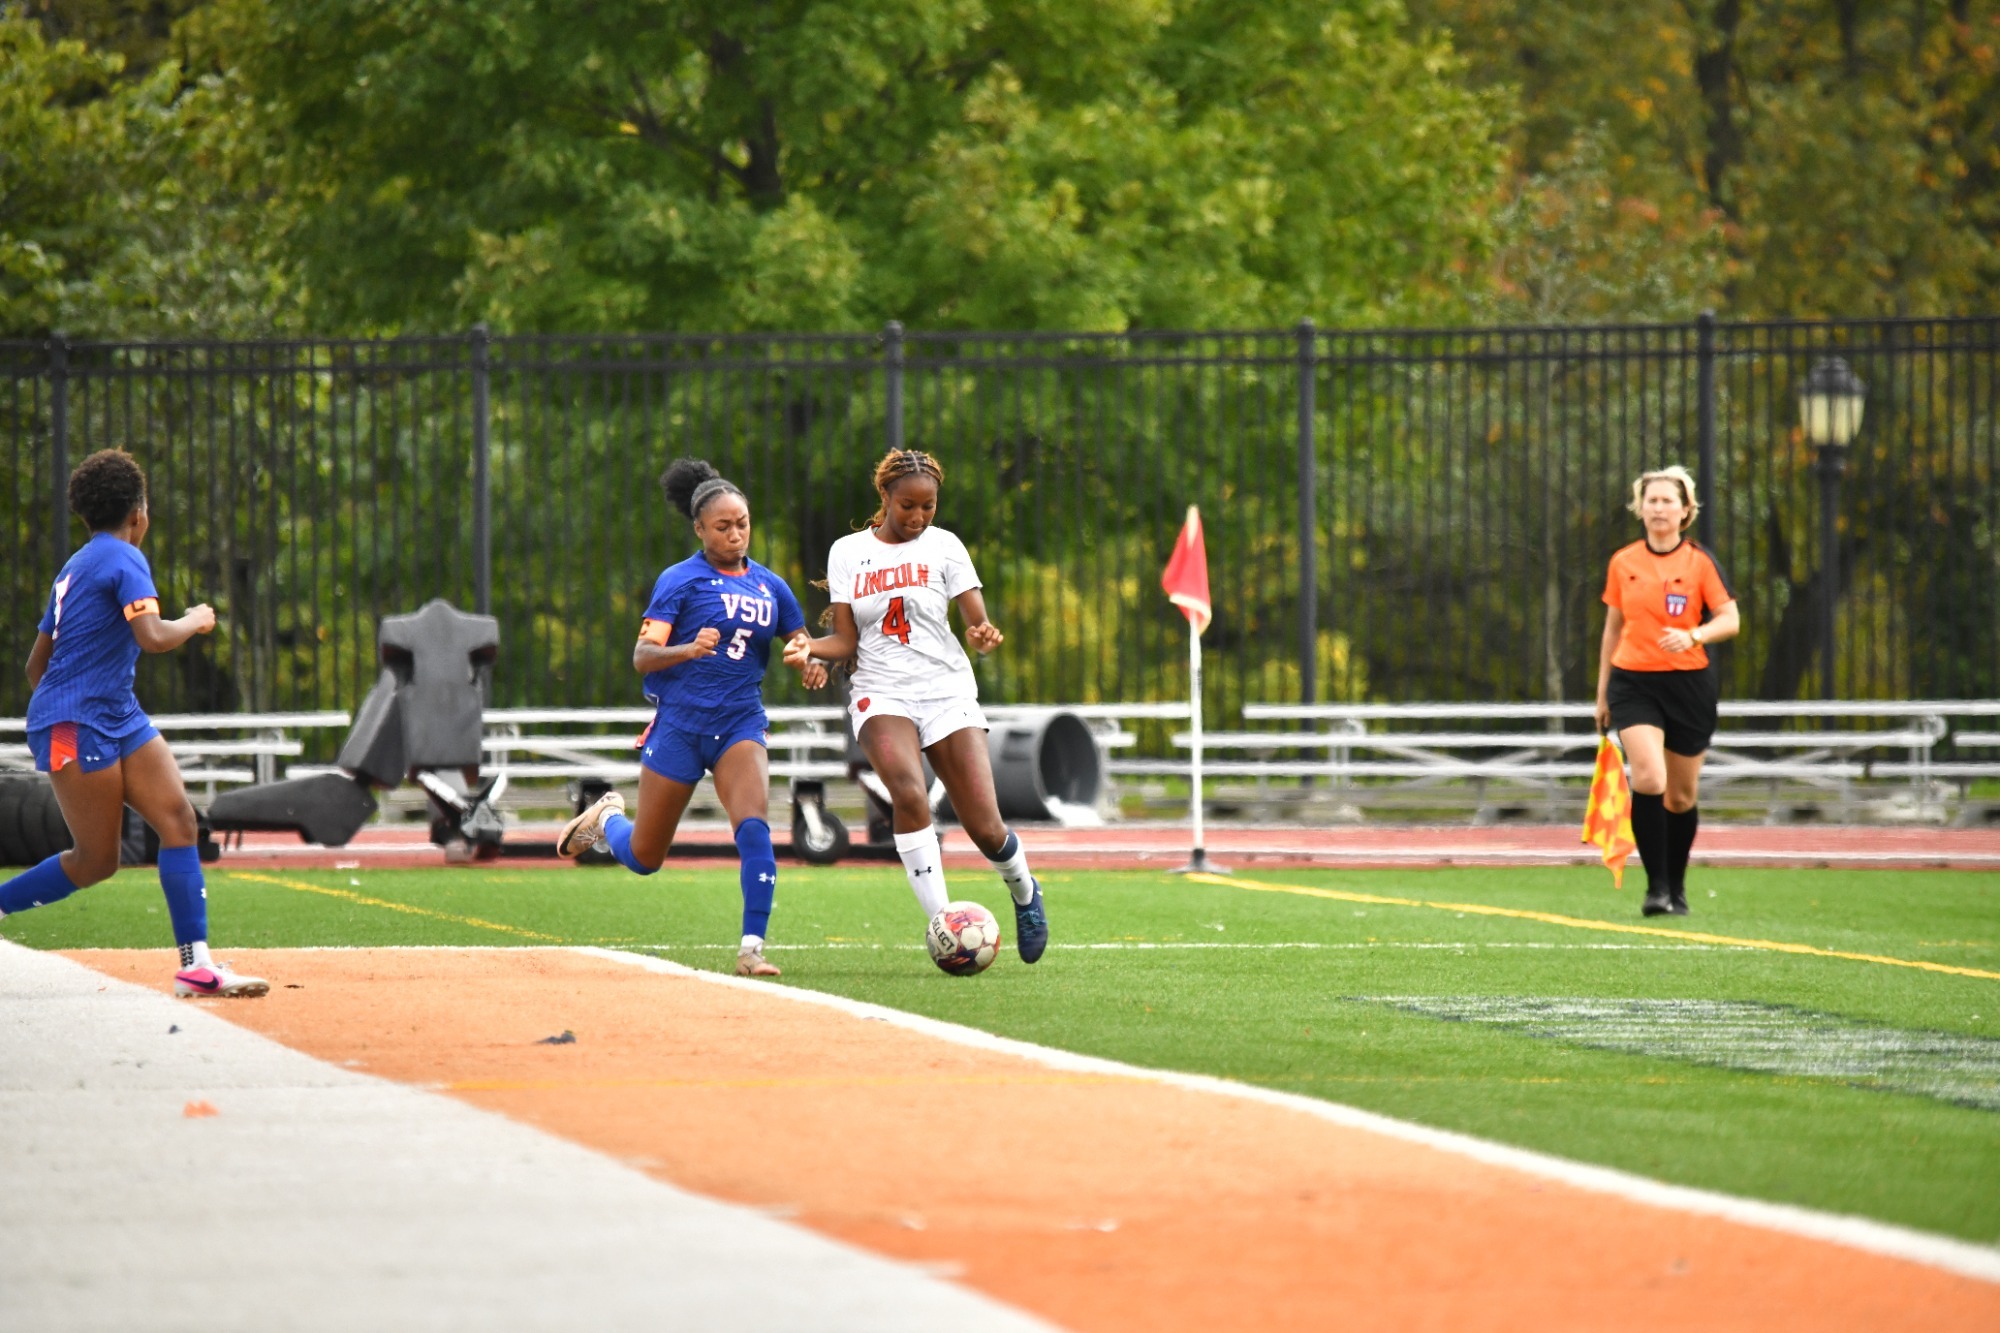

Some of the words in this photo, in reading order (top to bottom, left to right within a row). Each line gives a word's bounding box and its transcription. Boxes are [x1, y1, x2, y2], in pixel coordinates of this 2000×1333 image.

[854, 562, 929, 600] LINCOLN
[720, 593, 772, 627] VSU
[881, 595, 911, 645] 4
[726, 628, 753, 660] 5
[931, 916, 955, 951] SELECT
